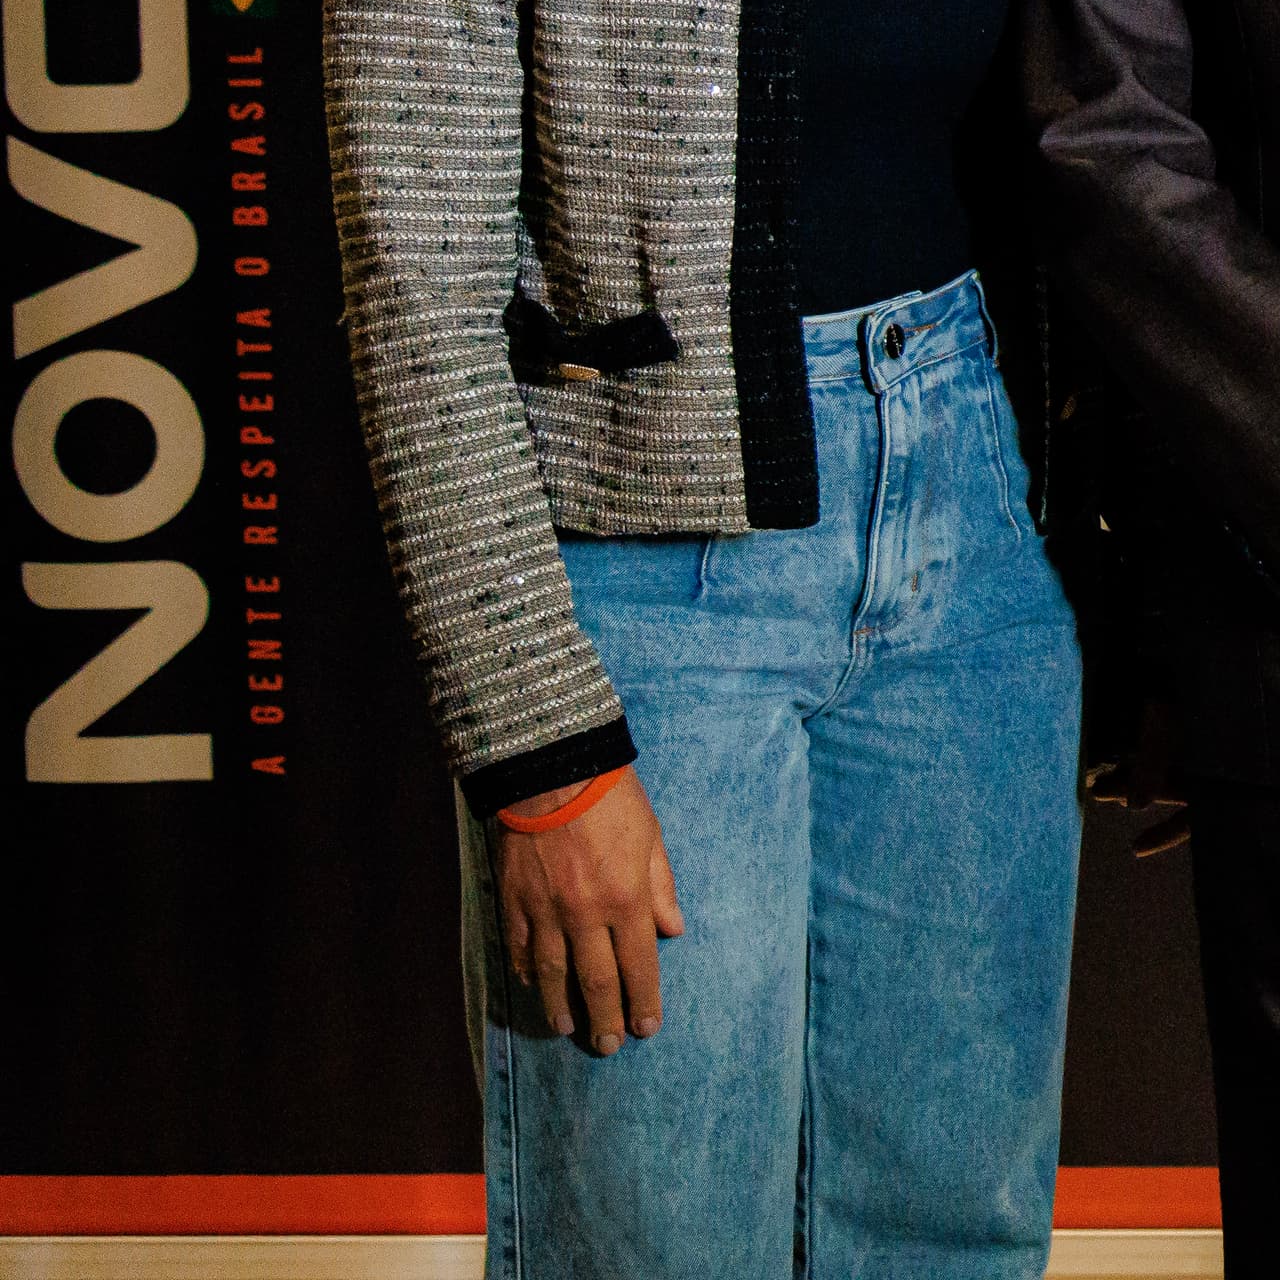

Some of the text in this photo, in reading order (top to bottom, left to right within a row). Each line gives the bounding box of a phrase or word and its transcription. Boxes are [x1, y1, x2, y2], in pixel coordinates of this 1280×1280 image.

[227, 46, 286, 776] A GENTE RESPEITA O BRASIL
